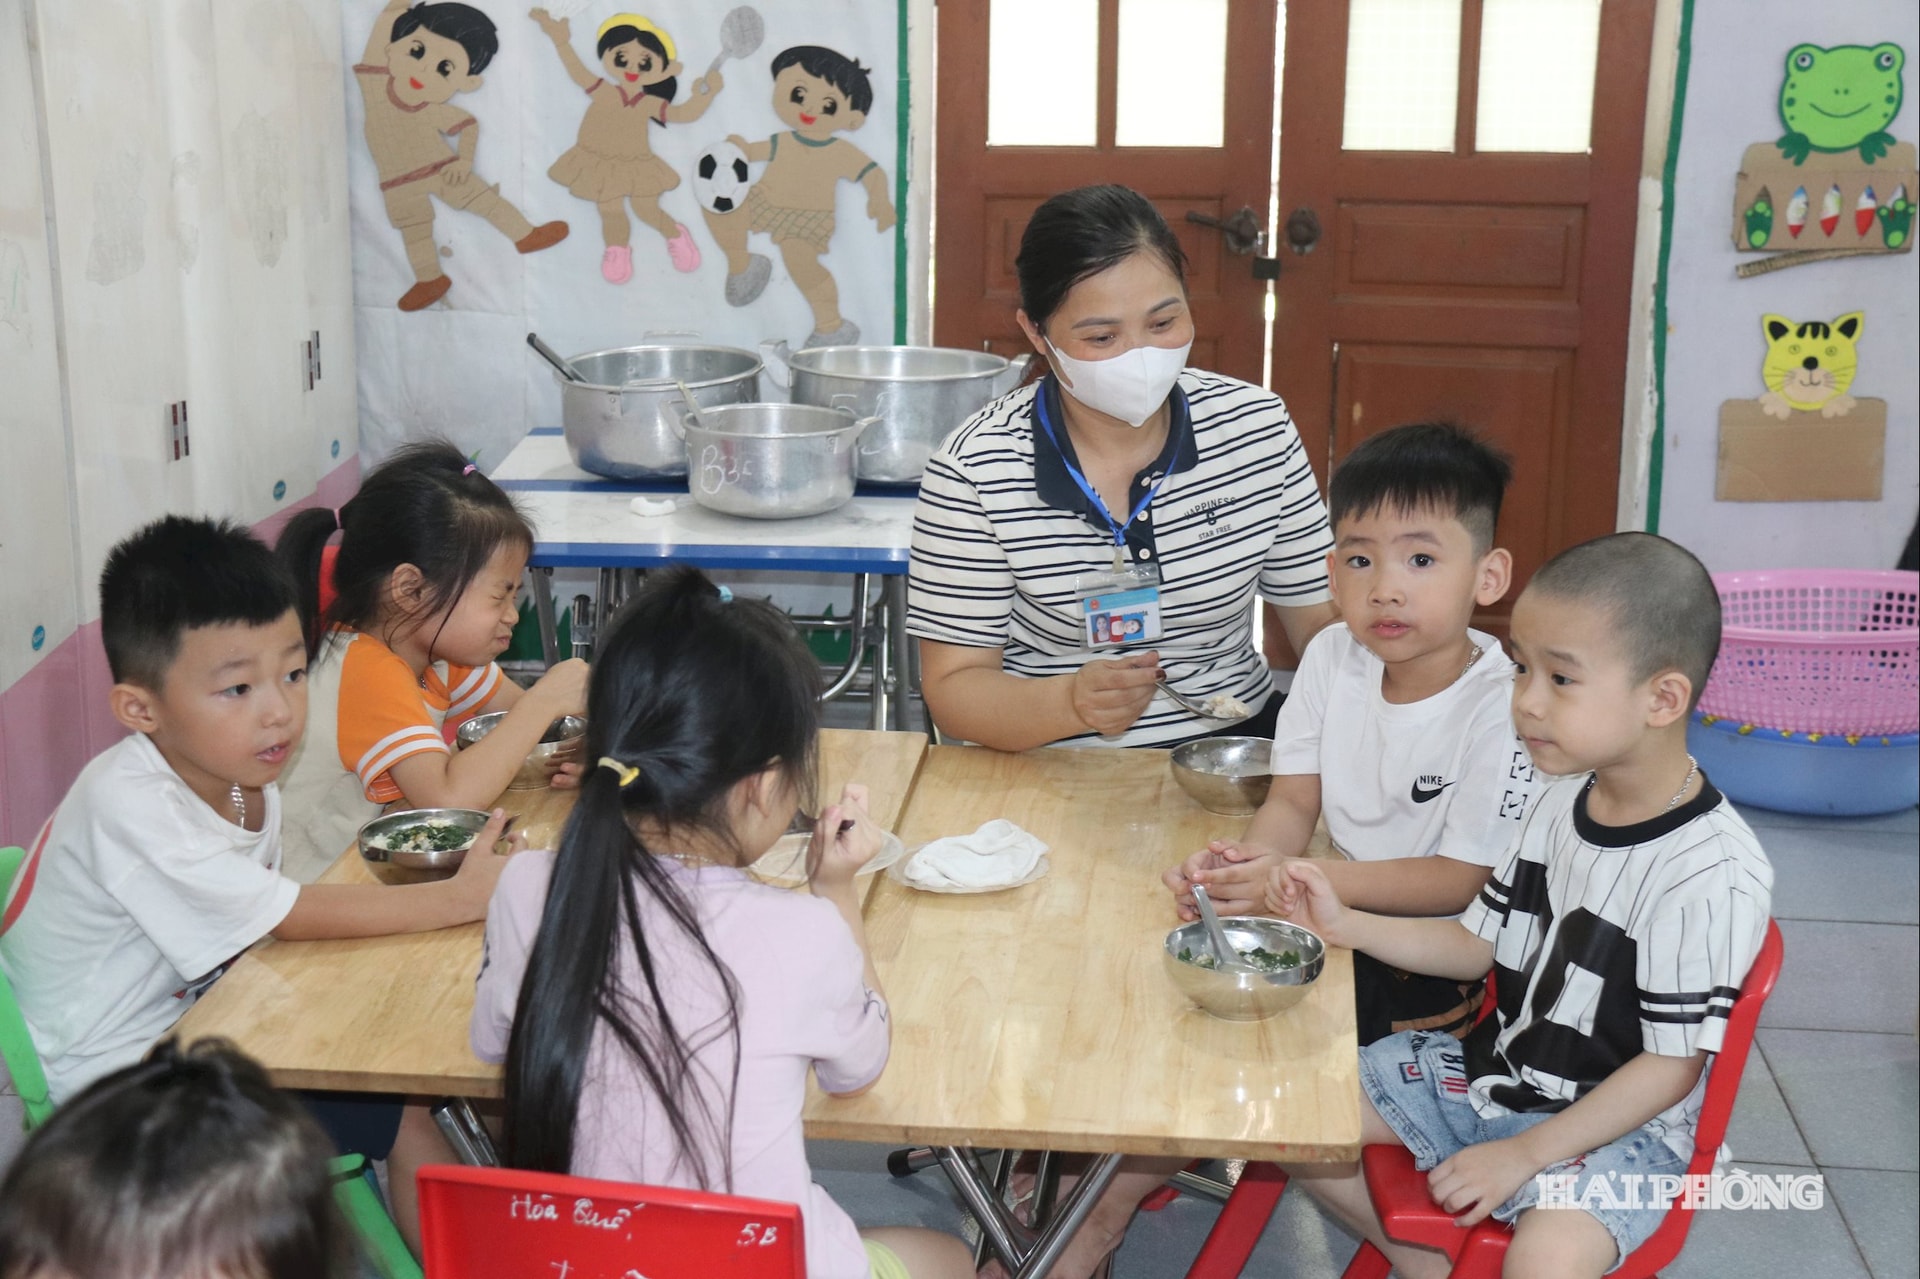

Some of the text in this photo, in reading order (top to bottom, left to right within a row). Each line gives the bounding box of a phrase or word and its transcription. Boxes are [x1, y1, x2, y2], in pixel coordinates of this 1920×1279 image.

[1198, 523, 1232, 541] STAR FREE
[1419, 775, 1443, 786] NIKE
